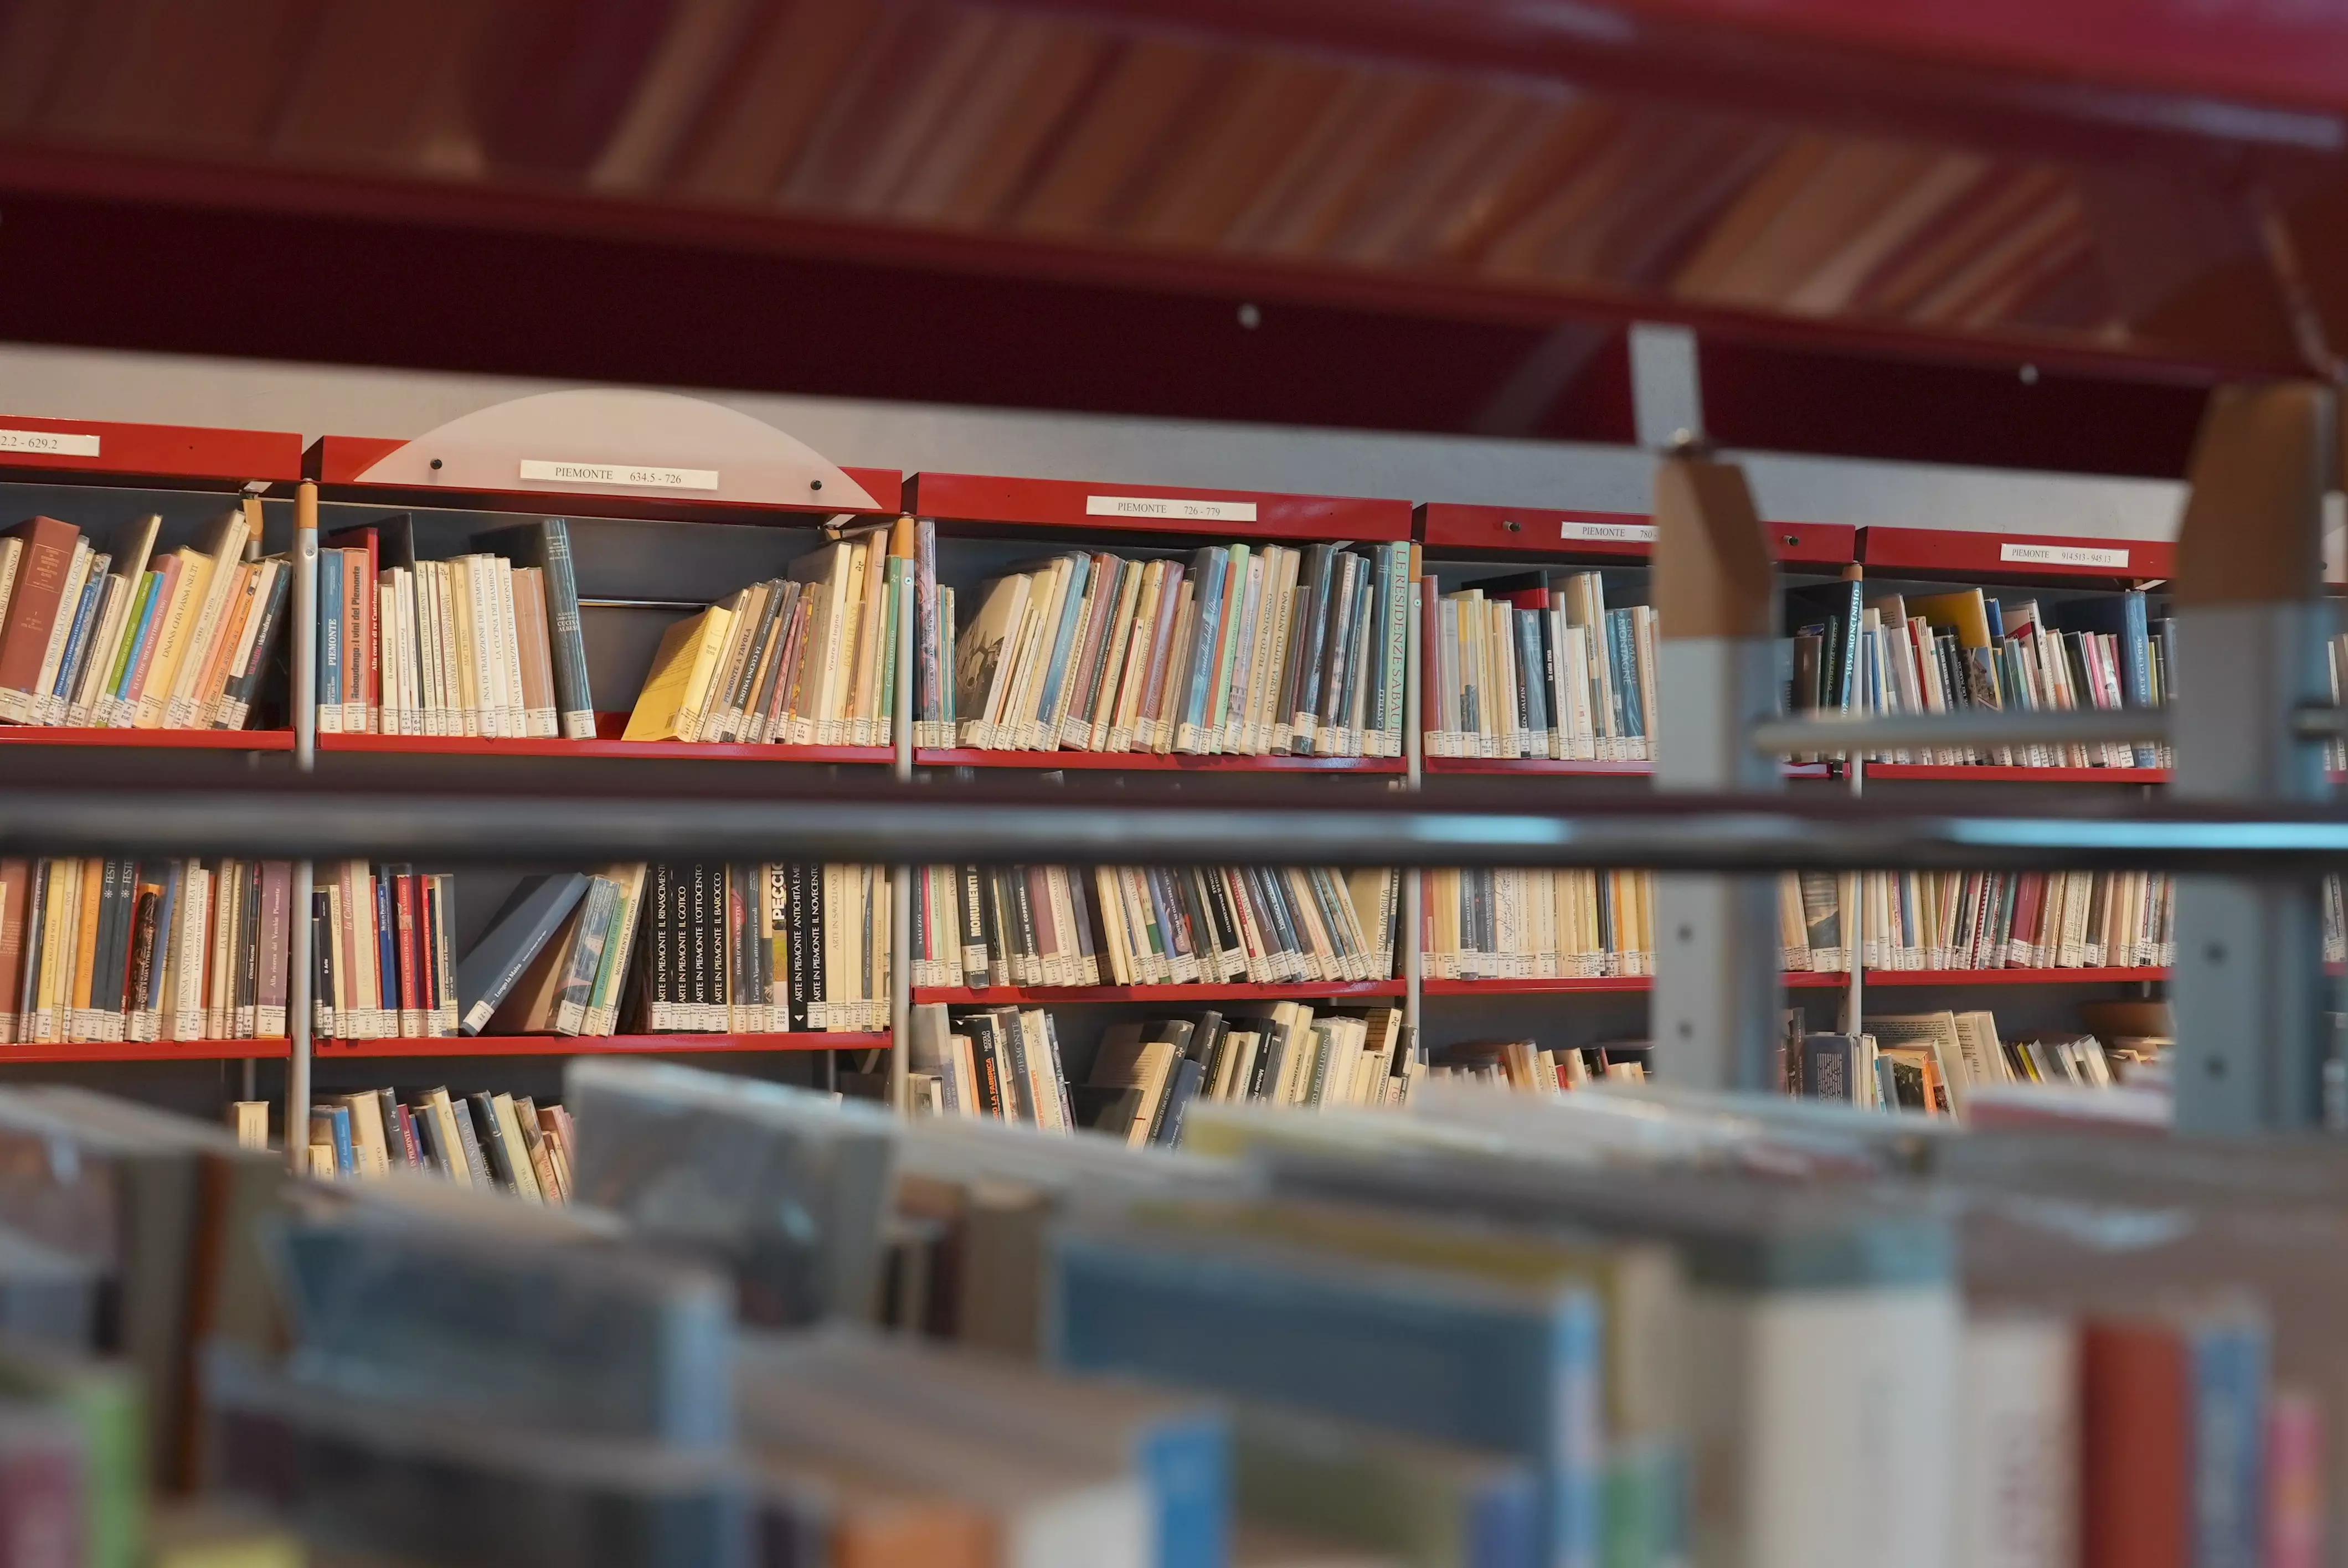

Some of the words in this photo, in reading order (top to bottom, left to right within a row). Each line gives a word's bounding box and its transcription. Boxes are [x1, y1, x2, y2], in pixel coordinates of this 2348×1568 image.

[0, 436, 17, 446] 2.2
[28, 438, 58, 449] 629.2
[555, 467, 613, 480] PIEMONTE
[630, 472, 655, 483] 634.5
[665, 474, 682, 484] 726
[1118, 502, 1167, 513] PIEMONTE
[1184, 506, 1198, 515] 726
[1206, 508, 1221, 517] 779
[1582, 527, 1625, 537] PIEMONTE
[1640, 530, 1652, 539] 780
[6, 549, 19, 581] MONDO
[1395, 550, 1407, 570] LE
[2012, 548, 2050, 559] PIEMONTE
[2062, 552, 2086, 561] 914.513
[2091, 554, 2111, 563] 945.13
[352, 565, 361, 605] Piemonte
[473, 566, 482, 606] PIEMONTE
[488, 567, 496, 600] BAMBINI
[503, 576, 512, 613] PIEMONTE
[832, 613, 840, 636] legno
[1146, 615, 1155, 631] alpi
[1261, 593, 1273, 635] INTORNO
[1278, 590, 1289, 632] INTORNO
[1392, 575, 1405, 664] RESIDENZE
[328, 618, 336, 666] PIEMONTE
[352, 622, 360, 637] vini
[830, 637, 837, 645] di
[1144, 632, 1151, 640] le
[1624, 617, 1638, 663] CINEMA
[1844, 589, 1861, 675] SUSA-MONCENISIO
[478, 625, 488, 673] TRADIZIONE
[495, 651, 501, 659] LA
[508, 632, 517, 677] TRADIZIONE
[754, 646, 762, 655] LA
[828, 647, 836, 671] Vivere
[1138, 642, 1149, 672] abitare
[1257, 637, 1266, 667] TUTTO
[1273, 635, 1283, 666] TUTTO
[1615, 618, 1633, 685] MONTAGNE
[482, 675, 488, 683] DI
[722, 664, 740, 703] PIEMONTE
[737, 627, 752, 657] TAVOLA
[745, 654, 759, 680] CUCINA
[512, 679, 518, 688] DI
[1269, 670, 1279, 697] IVREA
[2138, 675, 2146, 694] DUE
[1253, 697, 1259, 708] DA
[1267, 699, 1275, 713] DA
[222, 865, 232, 903] PIEMONTE
[342, 876, 352, 919] Collezione
[713, 872, 722, 915] BAROCCO
[222, 905, 229, 914] IN
[678, 885, 686, 919] GOTICO
[791, 885, 801, 927] ANTICHITÀ
[966, 875, 981, 937] MONUMENTI
[1018, 885, 1028, 922] COPERTINA
[1052, 881, 1065, 926] TRADIZIONALI
[1217, 893, 1233, 933] RINASCIMENTO
[1378, 888, 1390, 927] FAMIGLIA
[832, 920, 838, 929] IN
[1165, 886, 1177, 914] TRECENTO
[1173, 919, 1186, 948] PIEMONTE
[219, 940, 226, 948] LA
[615, 932, 630, 976] MONUMENTA
[625, 898, 637, 931] ALBENSIA
[678, 930, 686, 971] PIEMONTE
[794, 930, 802, 970] PIEMONTE
[812, 926, 820, 968] PIEMONTE
[181, 946, 191, 975] ANTICA
[507, 962, 523, 979] Maira
[812, 970, 821, 979] IN
[493, 981, 509, 998] Lungo
[504, 976, 512, 984] la
[658, 973, 666, 982] IN
[678, 973, 686, 982] IN
[695, 971, 703, 981] IN
[714, 972, 722, 981] IN
[794, 972, 802, 981] IN
[678, 983, 686, 1003] ARTE
[714, 982, 722, 1003] ARTE
[794, 982, 803, 1002] ARTE
[1011, 1021, 1026, 1074] PIEMONTE
[1319, 1033, 1331, 1065] UOMINI
[985, 1058, 996, 1095] FABBRICA
[1291, 1054, 1302, 1087] MONTAGNA
[990, 1096, 997, 1106] LA
[402, 1129, 414, 1160] PIEMONTE
